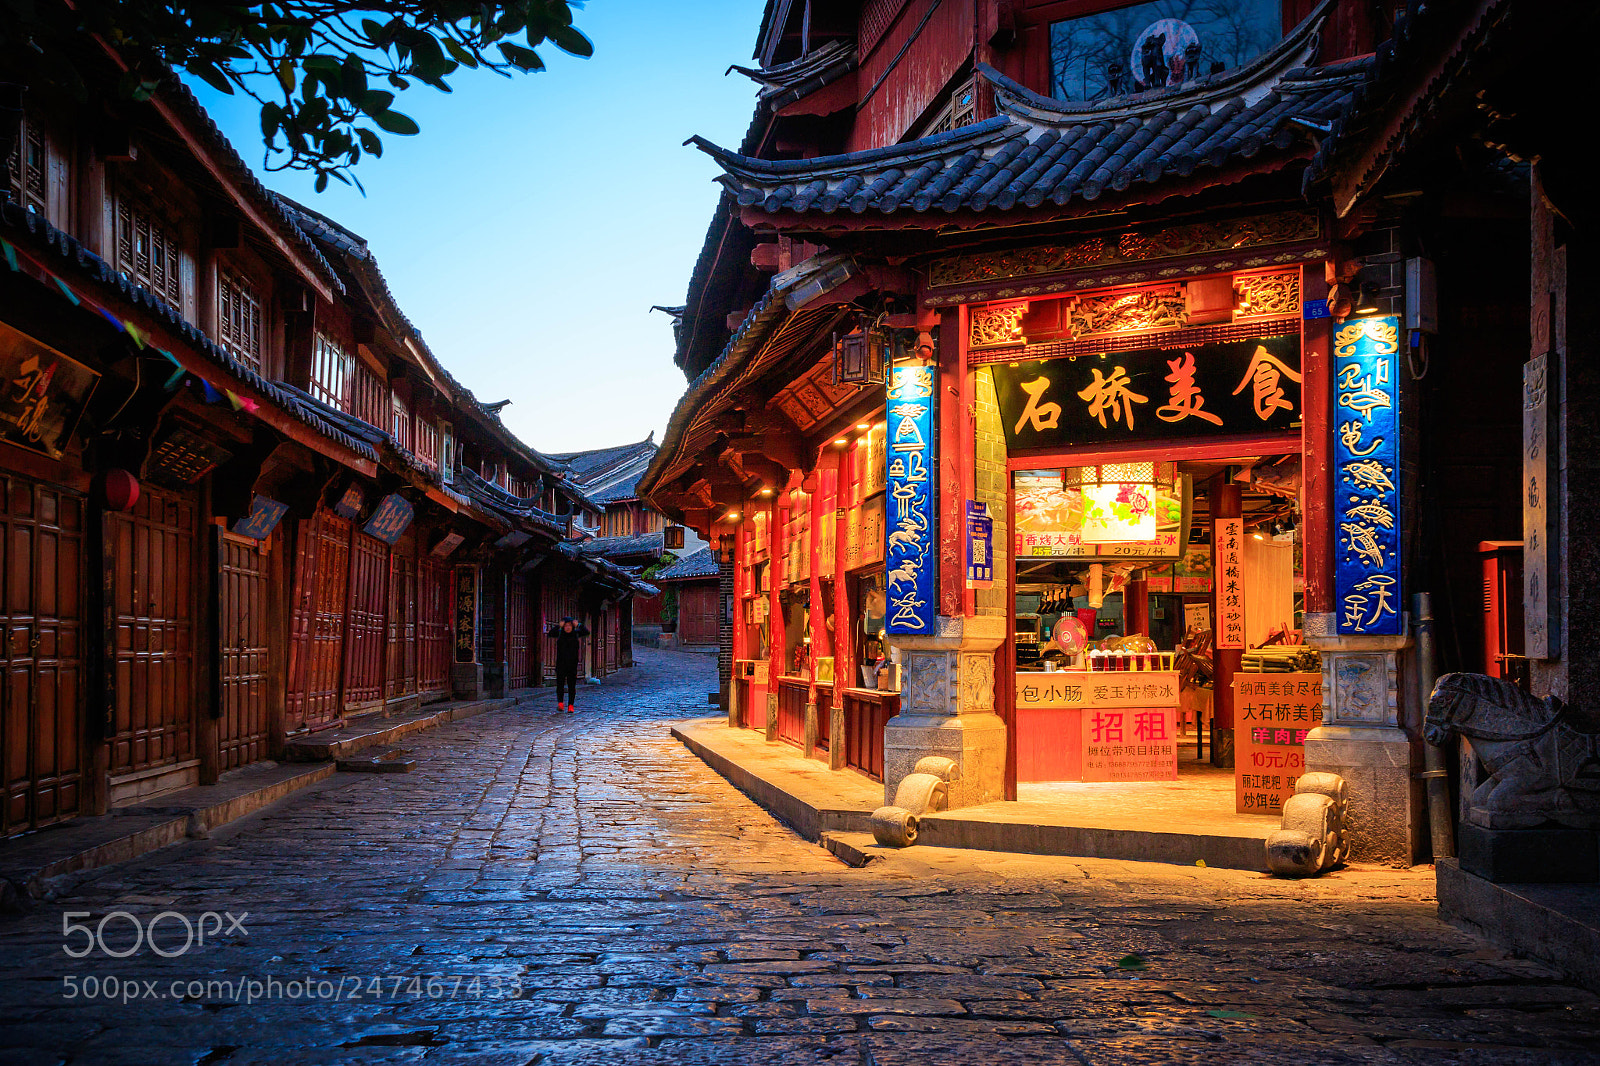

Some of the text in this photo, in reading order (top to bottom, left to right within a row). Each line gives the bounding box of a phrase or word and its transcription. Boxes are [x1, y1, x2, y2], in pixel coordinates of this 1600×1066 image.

[1311, 307, 1323, 316] 65
[1014, 345, 1302, 435] 石桥美食
[1025, 534, 1096, 546] 香烤大鱿
[1114, 547, 1167, 556] 20元/杯
[1016, 685, 1083, 702] 包小肠
[1093, 684, 1174, 700] 爱玉柠檬冰
[1240, 680, 1322, 697] 纳西美食尽在
[1242, 702, 1323, 722] 大石桥美食
[1091, 711, 1168, 743] 招租
[1088, 745, 1172, 756] 摊位带项目招租
[1251, 752, 1306, 768] 10元/3
[1242, 774, 1300, 791] 丽江粑粑 鸡
[1243, 792, 1281, 809] 炒饵丝
